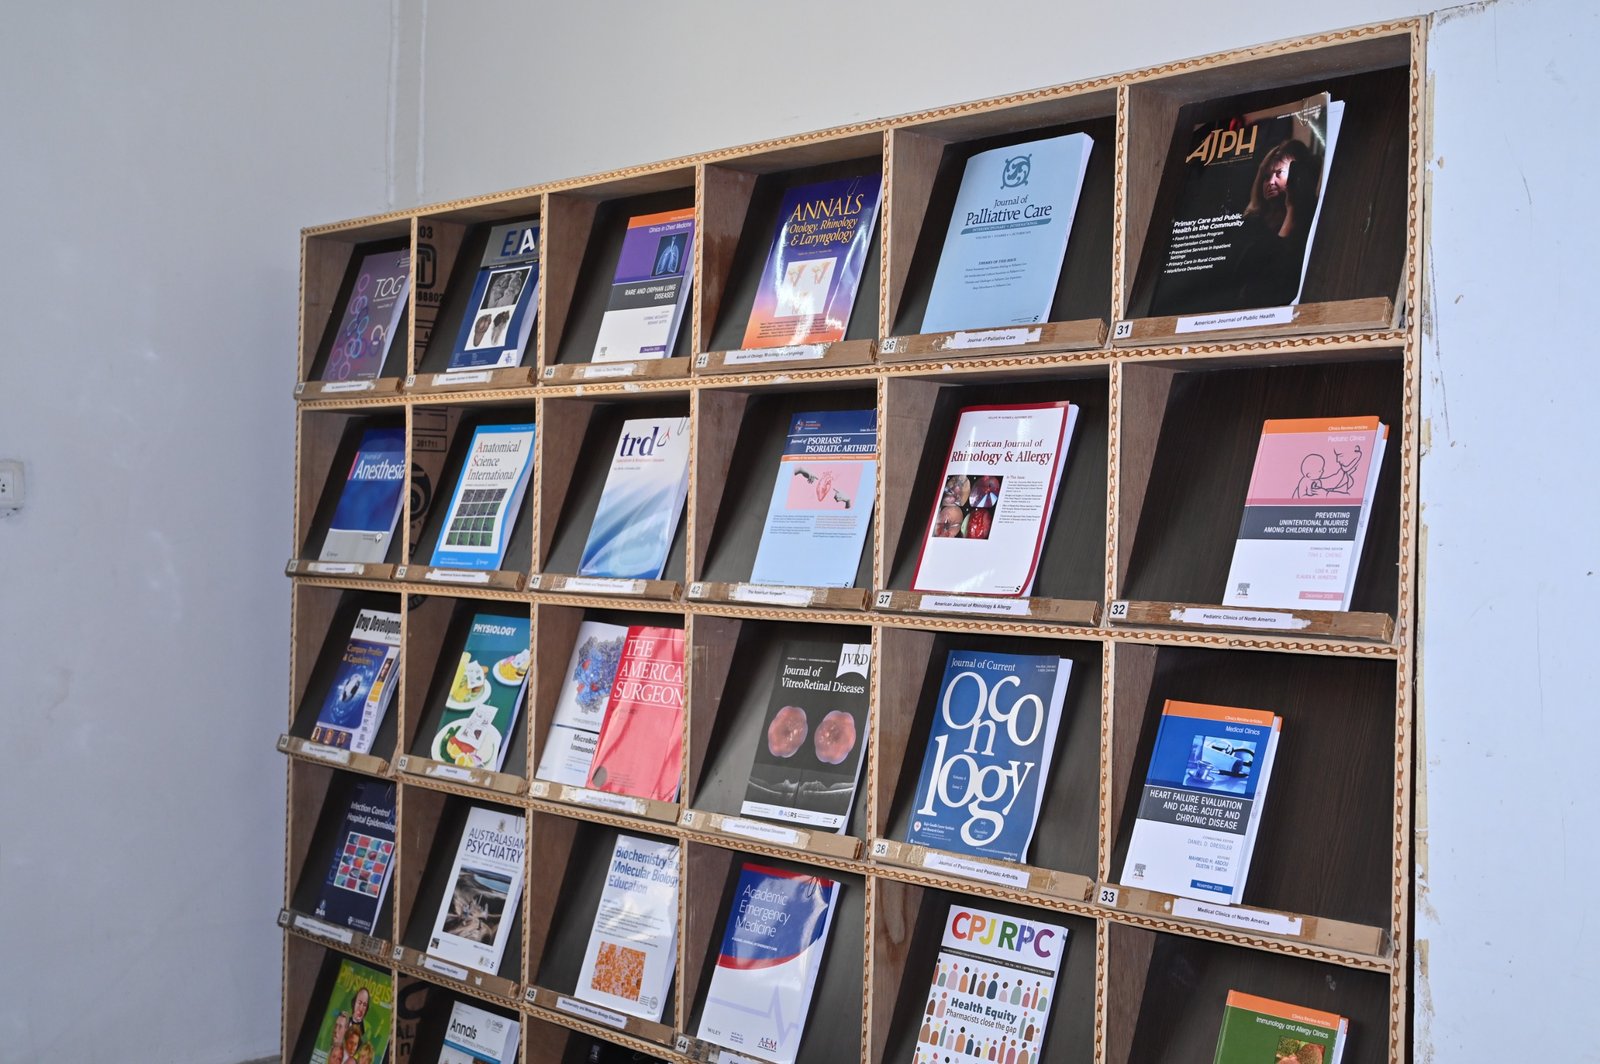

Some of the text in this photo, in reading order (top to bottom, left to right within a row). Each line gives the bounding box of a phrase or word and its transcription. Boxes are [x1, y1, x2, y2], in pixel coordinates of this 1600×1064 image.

[1185, 125, 1258, 167] AJPH
[789, 193, 864, 223] ANNALS
[993, 194, 1029, 209] Journal of
[965, 204, 1053, 226] Palliative Care
[1174, 220, 1197, 228] Primary
[1224, 213, 1243, 221] Public
[821, 217, 858, 232] Rhinology
[1172, 227, 1192, 235] Health
[1210, 220, 1244, 230] Community
[790, 229, 855, 248] & Laryngology
[1187, 264, 1214, 272] Development
[374, 275, 406, 299] TOG
[625, 288, 636, 296] RARE
[636, 287, 646, 295] AND
[646, 285, 664, 294] ORPHAN
[654, 291, 675, 300] DISEASES
[1117, 324, 1130, 335] 31
[884, 341, 895, 350] 36
[476, 440, 521, 453] Anatomical
[619, 426, 659, 457] trd
[807, 436, 843, 445] PSORIASIS
[965, 438, 1043, 449] American Journal of
[805, 444, 843, 453] PSORIATIC
[471, 455, 501, 467] Science
[951, 451, 1053, 466] Rhinology & Allergy
[353, 459, 406, 480] Anesthesia
[466, 468, 516, 481] International
[1315, 511, 1351, 519] PREVENTING
[1263, 526, 1285, 534] AMONG
[1323, 519, 1349, 527] INJURIES
[691, 585, 700, 595] 42
[879, 594, 890, 604] 37
[1112, 604, 1125, 615] 32
[356, 613, 372, 632] Drug
[473, 622, 517, 637] PHYSIOLOGY
[626, 639, 655, 656] THE
[841, 653, 869, 666] JVRD
[951, 657, 1016, 672] Journal of Current
[619, 660, 683, 683] AMERICA
[783, 665, 823, 677] Journal of
[614, 682, 684, 706] SURGEON
[781, 678, 865, 695] VitreoRetinal Diseases
[1225, 725, 1261, 736] Medical Clinics
[1150, 789, 1243, 810] HEART FAILURE EVALUATION
[351, 801, 391, 818] Infection Control
[1163, 801, 1241, 820] AND CARE: ACUTE AND
[347, 812, 367, 824] Hospital
[683, 812, 692, 823] 43
[1175, 813, 1238, 830] CHRONIC DISEASE
[469, 827, 526, 849] AUSTRALASIAN
[465, 839, 523, 864] PSYCHIATRY
[875, 844, 886, 854] 38
[615, 846, 668, 869] Biochemistry
[611, 860, 680, 889] Molecular Biology
[957, 864, 976, 872] Psoriasis
[983, 869, 1001, 877] Psoriatic
[1001, 872, 1018, 880] Arthritis
[608, 874, 648, 895] Education
[742, 884, 789, 906] Academic
[1101, 890, 1115, 903] 33
[738, 899, 791, 926] Emergency
[1197, 907, 1214, 915] Medical
[1215, 910, 1231, 918] Clinics
[1250, 918, 1270, 926] America
[734, 915, 777, 938] Medicine
[951, 911, 1055, 959] CPJ RPC
[526, 988, 535, 999] 49
[950, 997, 1018, 1024] Health Equity
[450, 1018, 478, 1040] Annals
[945, 1008, 1018, 1036] Pharmacists close the gap
[1256, 1016, 1329, 1039] Immunology and Allergy Clinics
[707, 1027, 721, 1036] WILEY
[677, 1040, 687, 1049] 44
